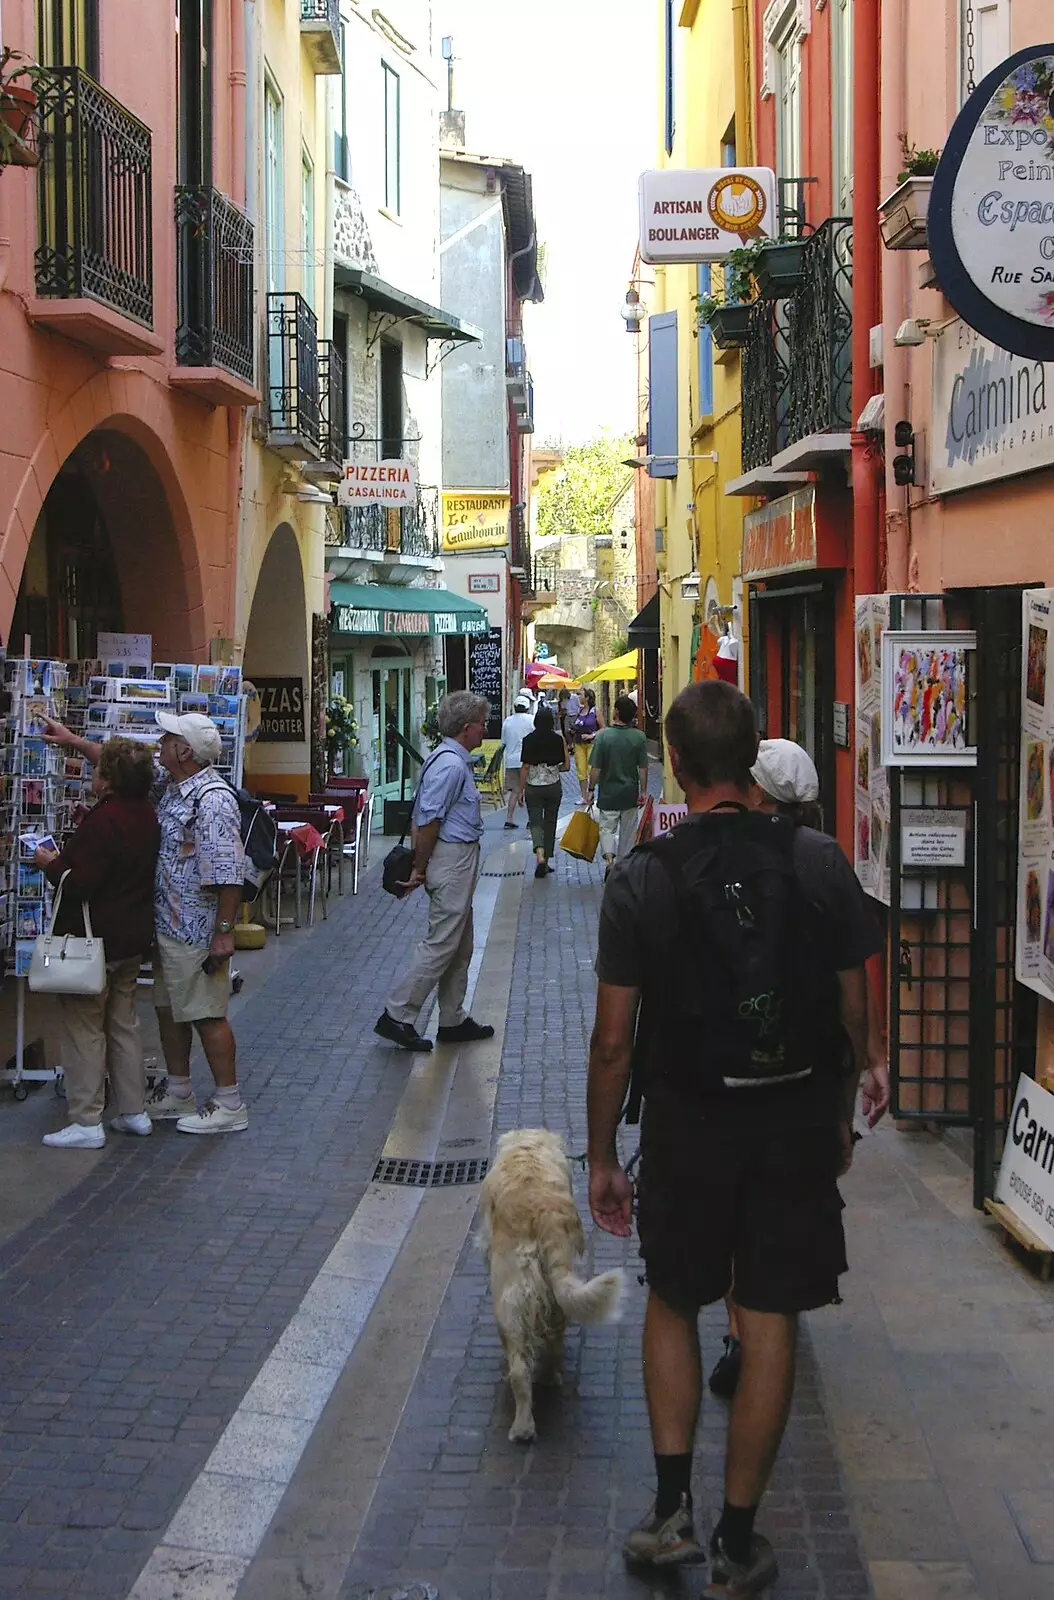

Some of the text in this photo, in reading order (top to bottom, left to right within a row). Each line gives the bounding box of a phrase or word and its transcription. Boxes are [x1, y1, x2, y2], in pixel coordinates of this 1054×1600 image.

[983, 125, 1048, 151] Expo
[653, 200, 703, 215] ARTISAN
[648, 227, 720, 242] BOULANGER
[990, 266, 1024, 284] RUE
[950, 354, 1047, 443] Carmina
[346, 465, 410, 483] PIZZERIA
[348, 486, 409, 498] CASALINGA
[446, 499, 506, 511] RESTAURANT
[447, 513, 468, 526] Le
[384, 611, 392, 633] LE
